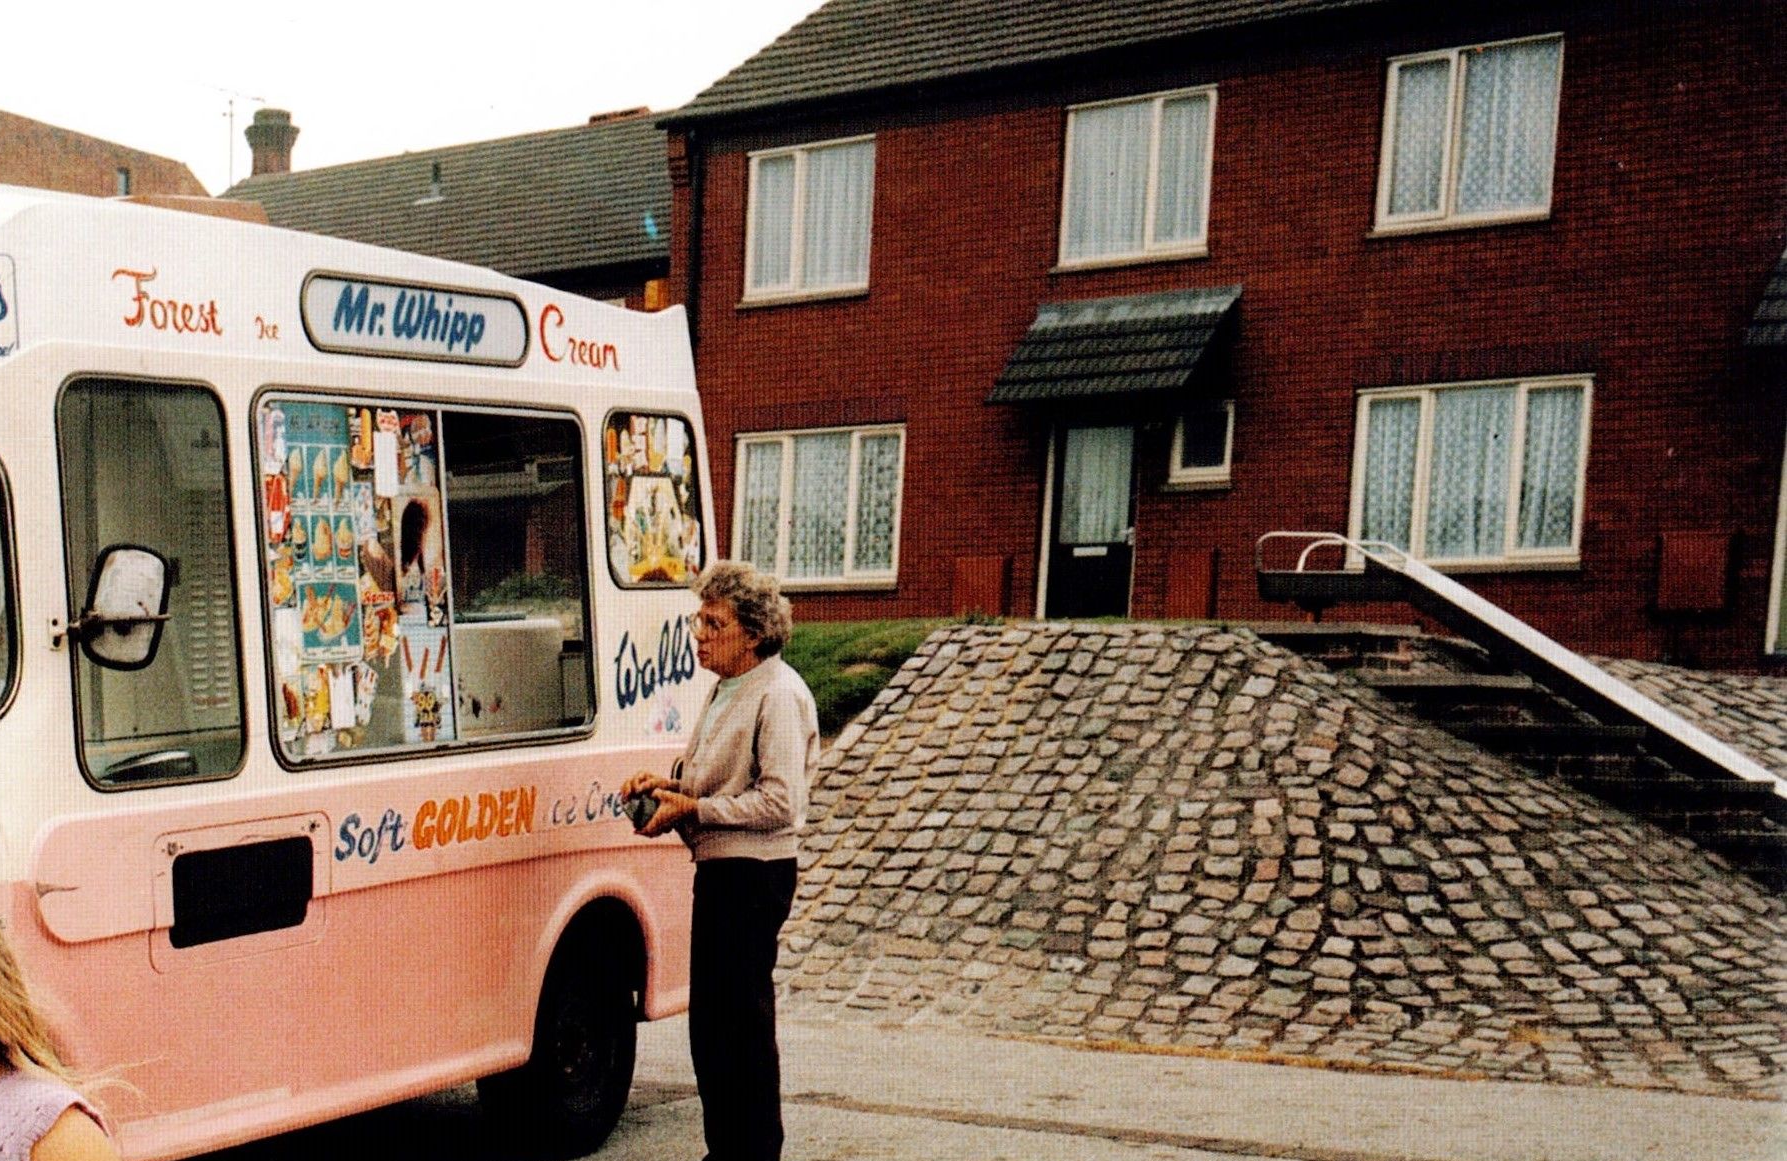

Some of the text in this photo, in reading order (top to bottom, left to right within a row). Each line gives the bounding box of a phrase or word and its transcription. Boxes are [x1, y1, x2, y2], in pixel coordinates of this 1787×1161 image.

[111, 266, 223, 337] Forest
[539, 303, 620, 371] Cream
[332, 284, 486, 353] Mr. Whipp
[333, 781, 622, 864] Soft GOLDEN ce Cre
